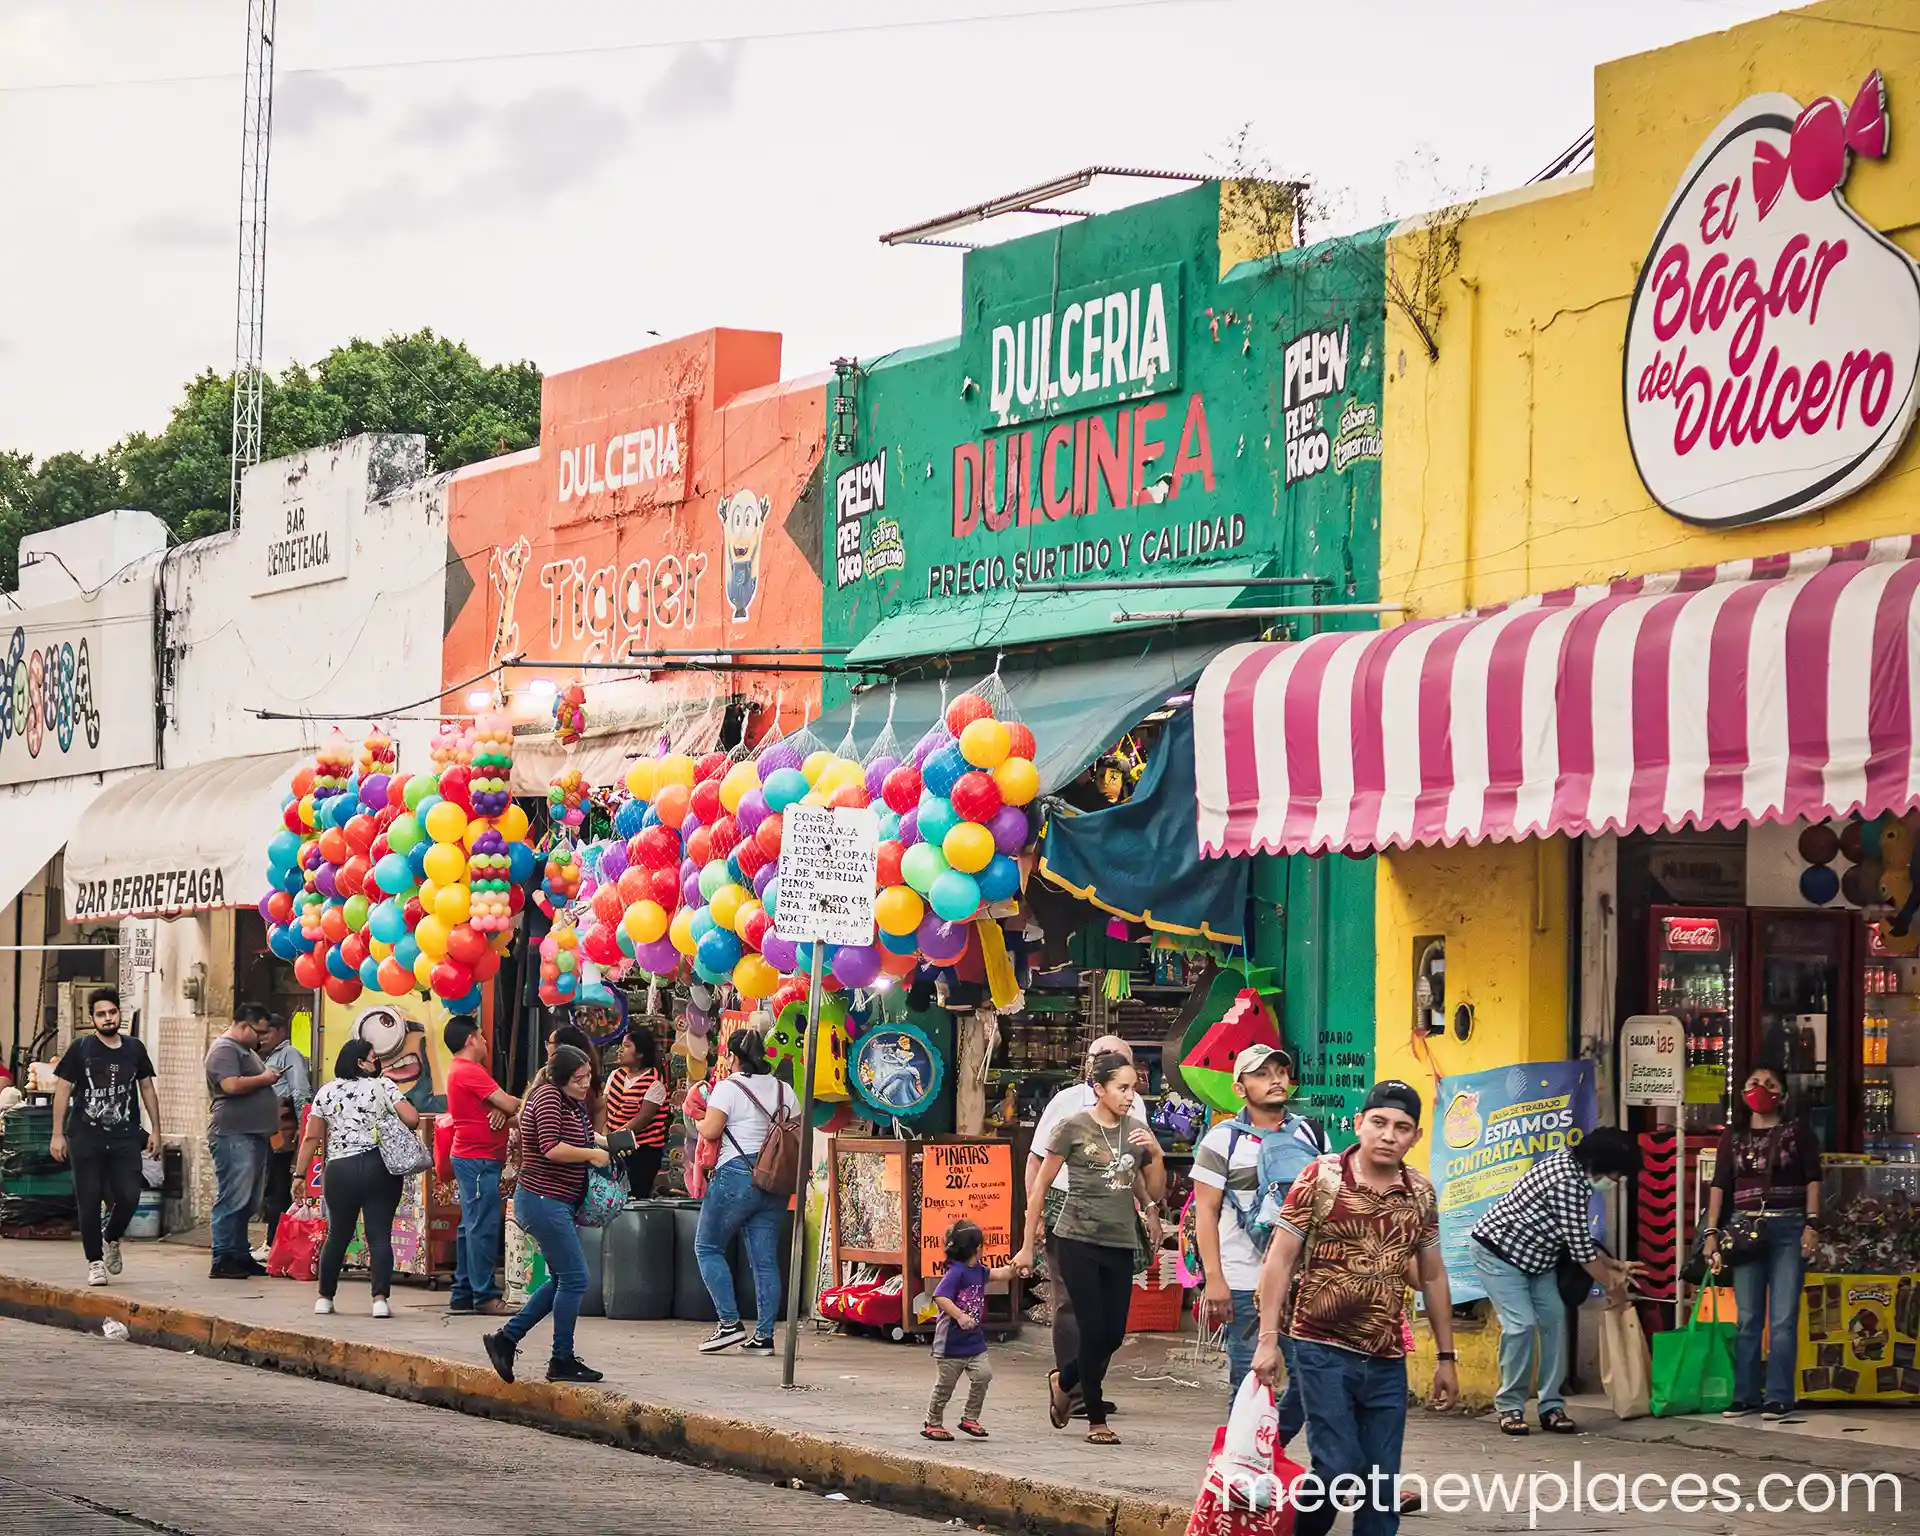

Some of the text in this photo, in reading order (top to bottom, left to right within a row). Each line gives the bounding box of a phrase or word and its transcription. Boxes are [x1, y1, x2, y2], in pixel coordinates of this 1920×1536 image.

[1700, 175, 1741, 245] El
[1652, 233, 1848, 377] Bazar
[989, 283, 1171, 412] DULCERIA
[1284, 323, 1350, 409] PELON
[1638, 345, 1893, 456] del Dulcero
[558, 423, 680, 502] DULCERIA
[951, 392, 1216, 538] DULCINEA
[1286, 431, 1330, 484] RICO
[836, 450, 886, 524] PELON
[286, 507, 305, 535] BAR
[268, 530, 329, 577] BERRETEAGA
[838, 553, 863, 589] RICO
[1012, 538, 1113, 585] SURTIDO
[1119, 533, 1133, 567] Y
[1140, 513, 1246, 564] CALIDAD
[540, 551, 708, 676] Tigger
[76, 867, 225, 914] BAR BERRETEAGA
[781, 878, 815, 889] PINOS
[794, 868, 810, 878] DE
[815, 871, 864, 883] MERIDA
[797, 857, 868, 873] PSICOLOGIA
[809, 892, 849, 905] PEDRO
[1669, 927, 1716, 945] Coca-Cola
[1485, 1109, 1574, 1145] ESTAMOS
[1520, 1099, 1561, 1113] TRABAJO
[1446, 1128, 1584, 1179] CONTRATANDO
